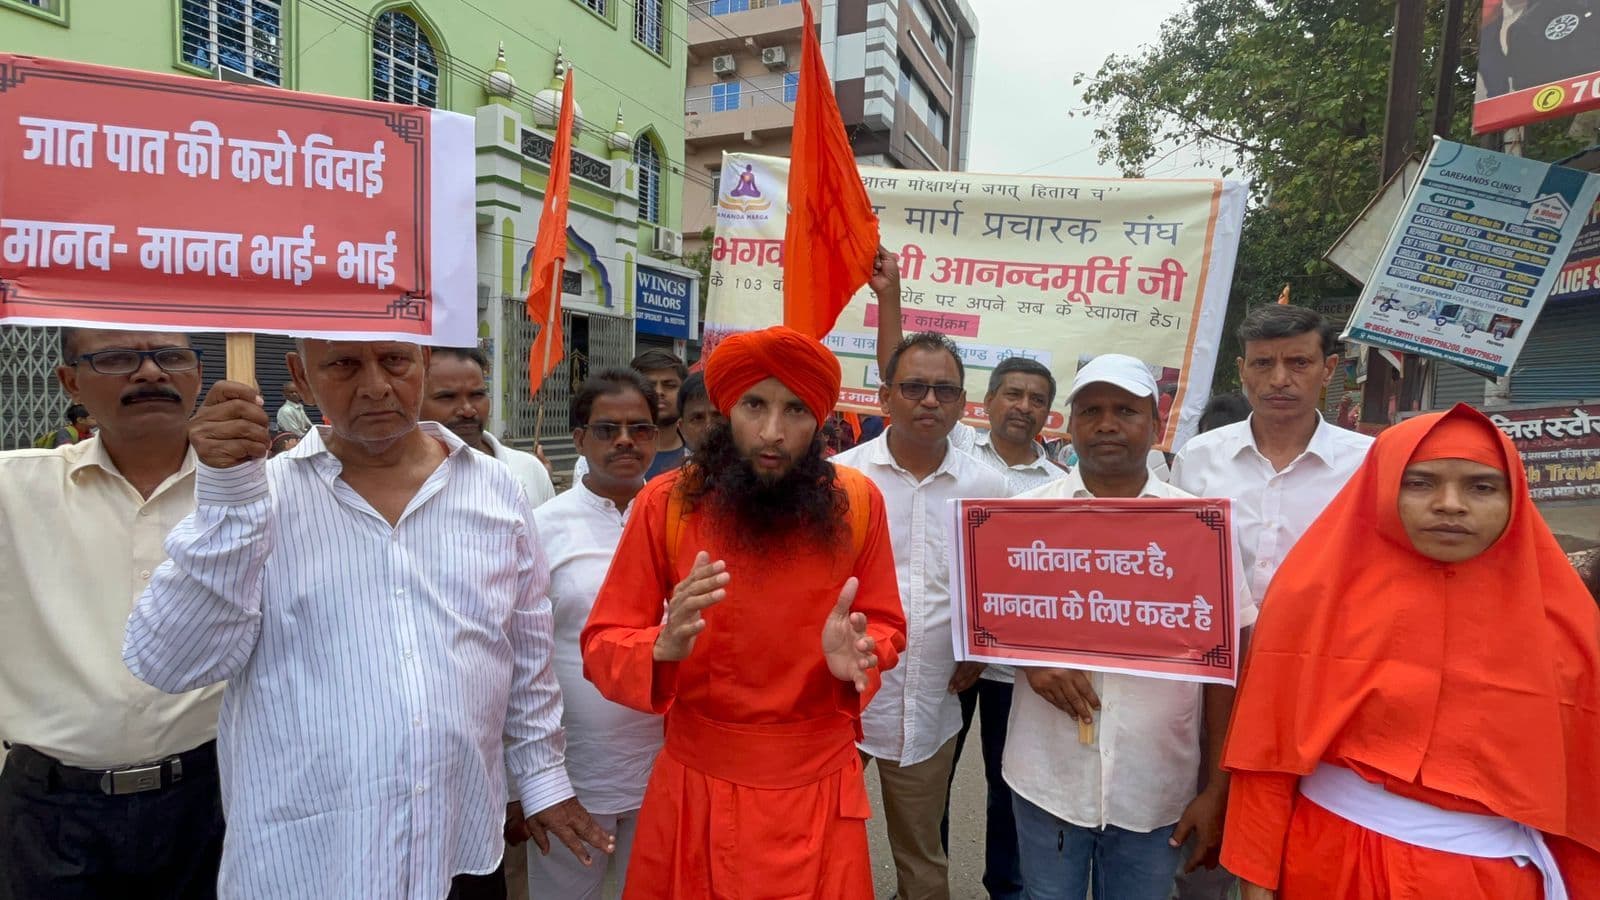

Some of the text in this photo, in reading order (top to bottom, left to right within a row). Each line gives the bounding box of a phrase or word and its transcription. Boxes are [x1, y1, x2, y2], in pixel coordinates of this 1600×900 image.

[19, 116, 385, 198] जात पात की करो विदाई
[1031, 184, 1080, 199] हिताय
[1440, 169, 1489, 186] CAREHANDS
[1491, 180, 1521, 193] CLINICS
[904, 200, 1183, 246] मार्ग प्रचारक संघ
[137, 227, 243, 277] मानव
[337, 231, 397, 289] भाई
[638, 272, 686, 297] WINGS
[642, 291, 681, 310] TAILORS
[711, 271, 724, 288] के
[735, 278, 762, 290] 103
[936, 294, 957, 308] पर
[966, 294, 1007, 312] अपने
[1017, 301, 1045, 315] सब
[1056, 300, 1072, 317] के
[1085, 305, 1139, 323] स्वागत
[930, 256, 1132, 305] आनन्दमूर्ति
[1137, 258, 1187, 302] जी
[915, 314, 969, 331] कार्यक्रम
[1007, 540, 1174, 580] जातिवाद जहर है,
[982, 591, 1213, 632] मानवता के लिए कहर है
